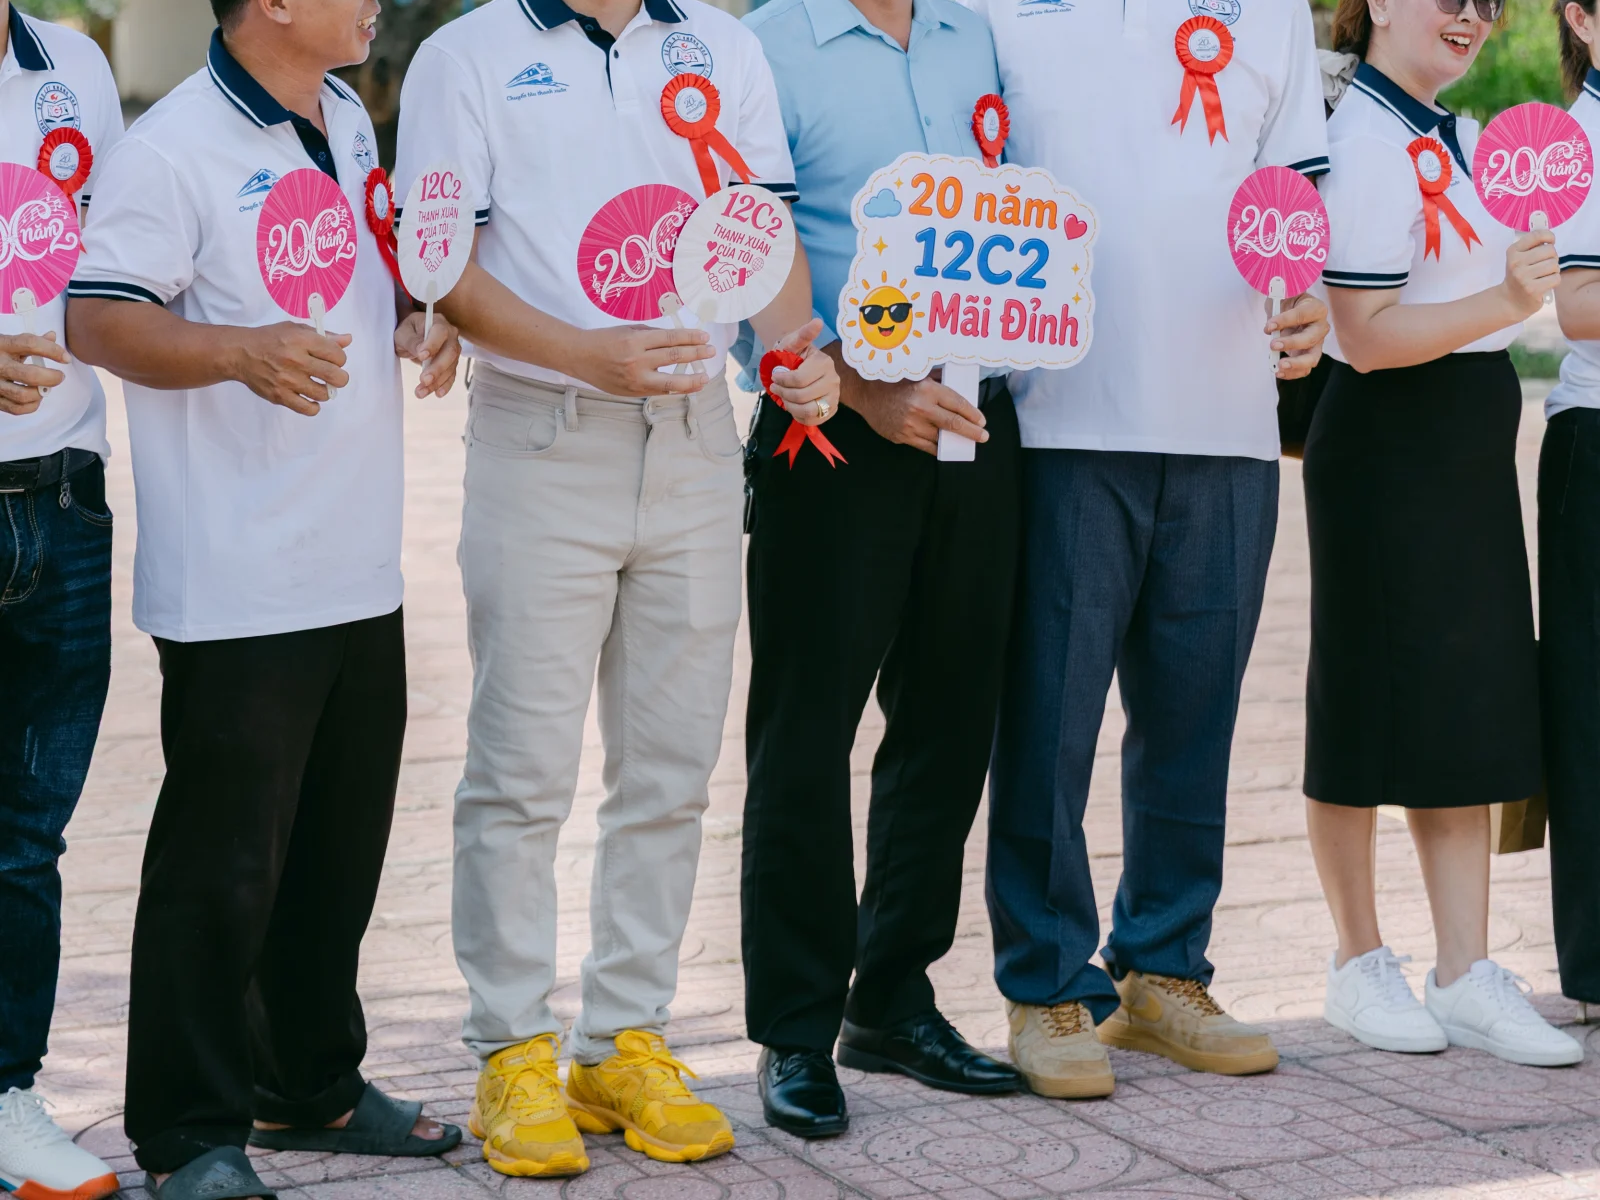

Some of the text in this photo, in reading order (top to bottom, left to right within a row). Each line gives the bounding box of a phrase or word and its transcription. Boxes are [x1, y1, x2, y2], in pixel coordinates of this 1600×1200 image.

[419, 171, 462, 203] 12C2
[908, 172, 1058, 230] 20 năm
[418, 203, 459, 223] THANH XUÂN
[424, 219, 449, 240] CỦA TÔI
[720, 191, 783, 239] 12C2
[713, 222, 772, 256] THANH XUÂN
[716, 242, 754, 265] CỦA TÔI
[914, 226, 1050, 290] 12C2
[927, 290, 1079, 348] Mãi Đỉnh
